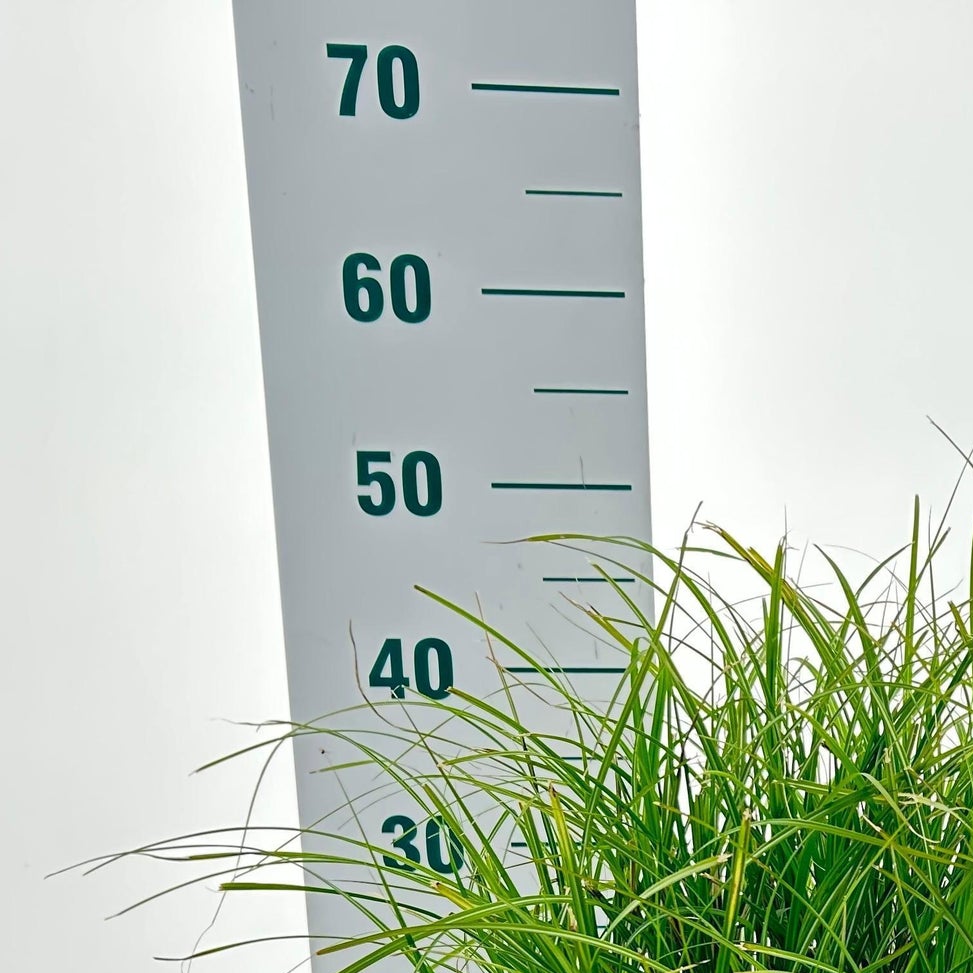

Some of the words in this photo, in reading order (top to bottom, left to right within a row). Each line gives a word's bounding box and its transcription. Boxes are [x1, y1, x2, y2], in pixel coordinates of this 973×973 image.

[326, 43, 420, 120] 70
[341, 252, 432, 324] 60
[356, 450, 443, 517] 50
[368, 637, 454, 700] 40
[381, 815, 465, 875] 30
